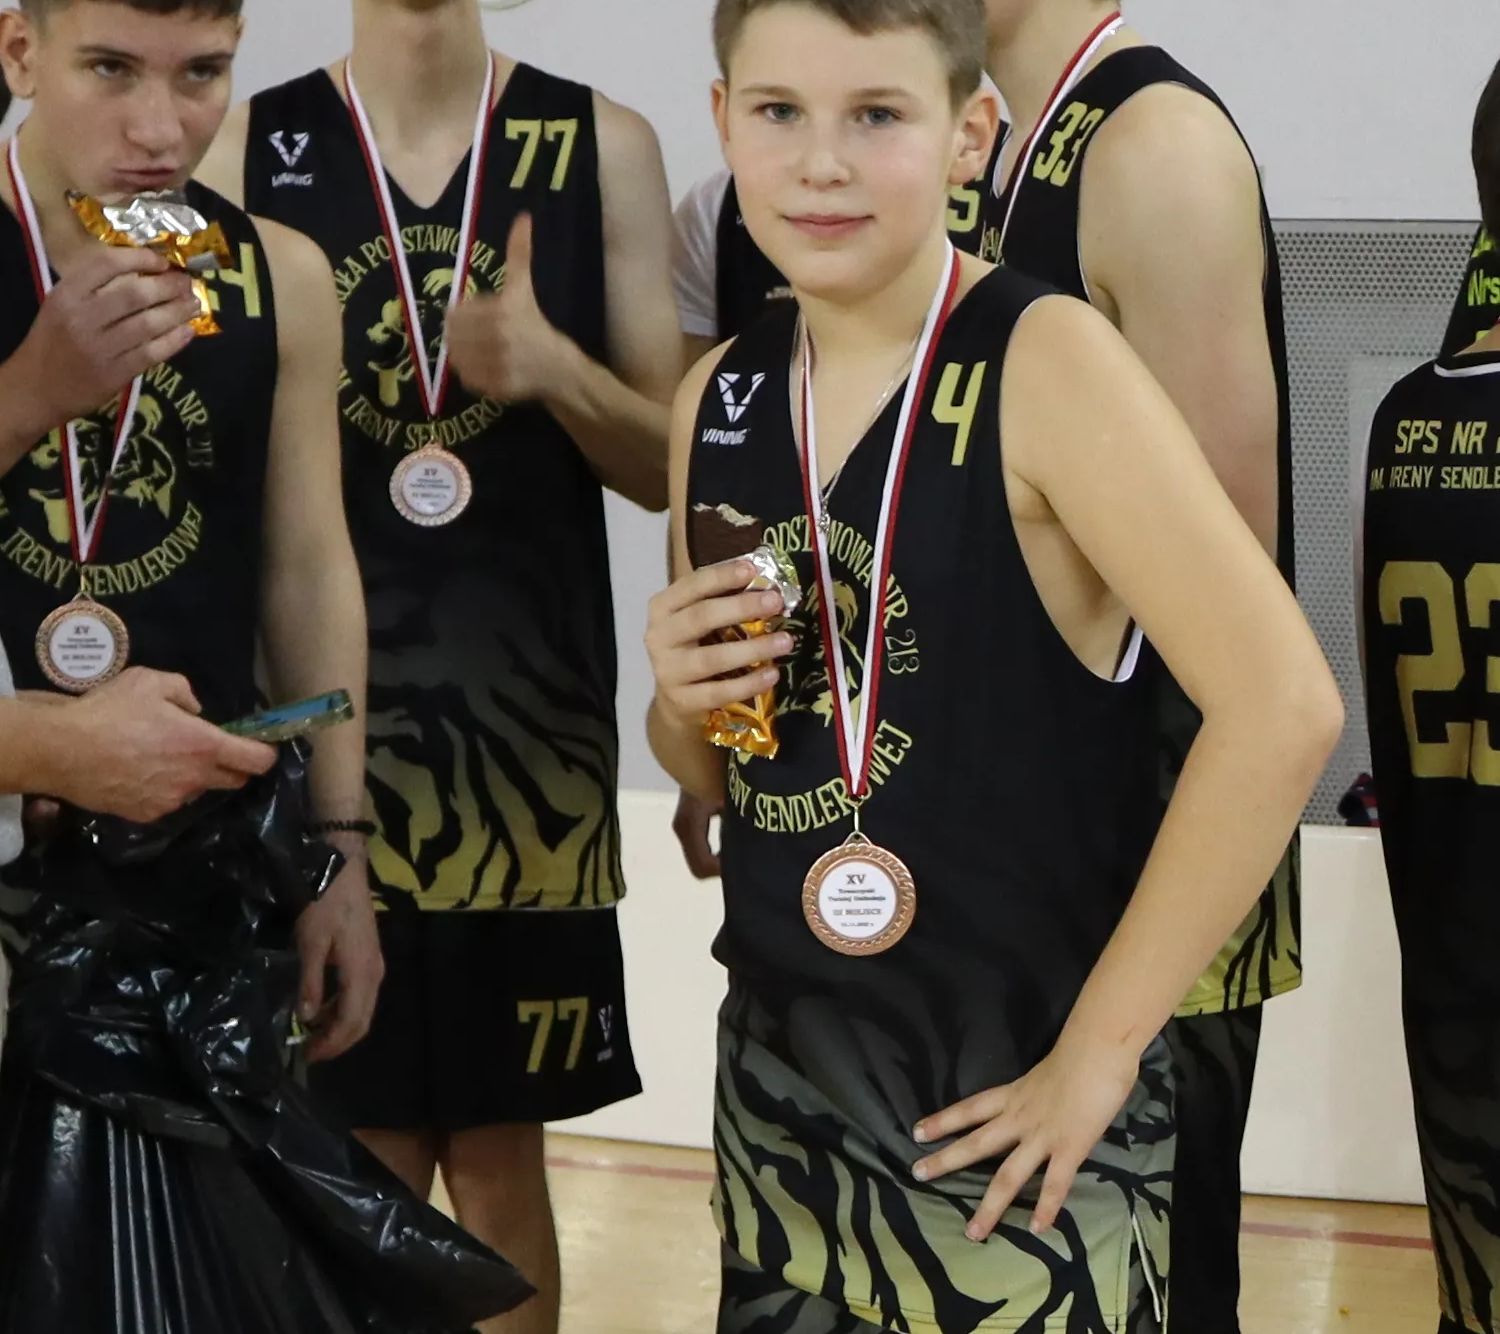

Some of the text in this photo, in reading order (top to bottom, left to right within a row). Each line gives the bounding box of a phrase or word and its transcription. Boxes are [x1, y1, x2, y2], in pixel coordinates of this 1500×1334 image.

[505, 118, 578, 191] 77
[1032, 101, 1105, 187] 33
[931, 361, 987, 466] 4
[1395, 420, 1442, 454] SPS
[1450, 421, 1488, 454] NR
[1389, 466, 1434, 488] IRENY
[0, 525, 71, 589] IRENY
[846, 874, 866, 885] XV
[517, 996, 589, 1073] 77
